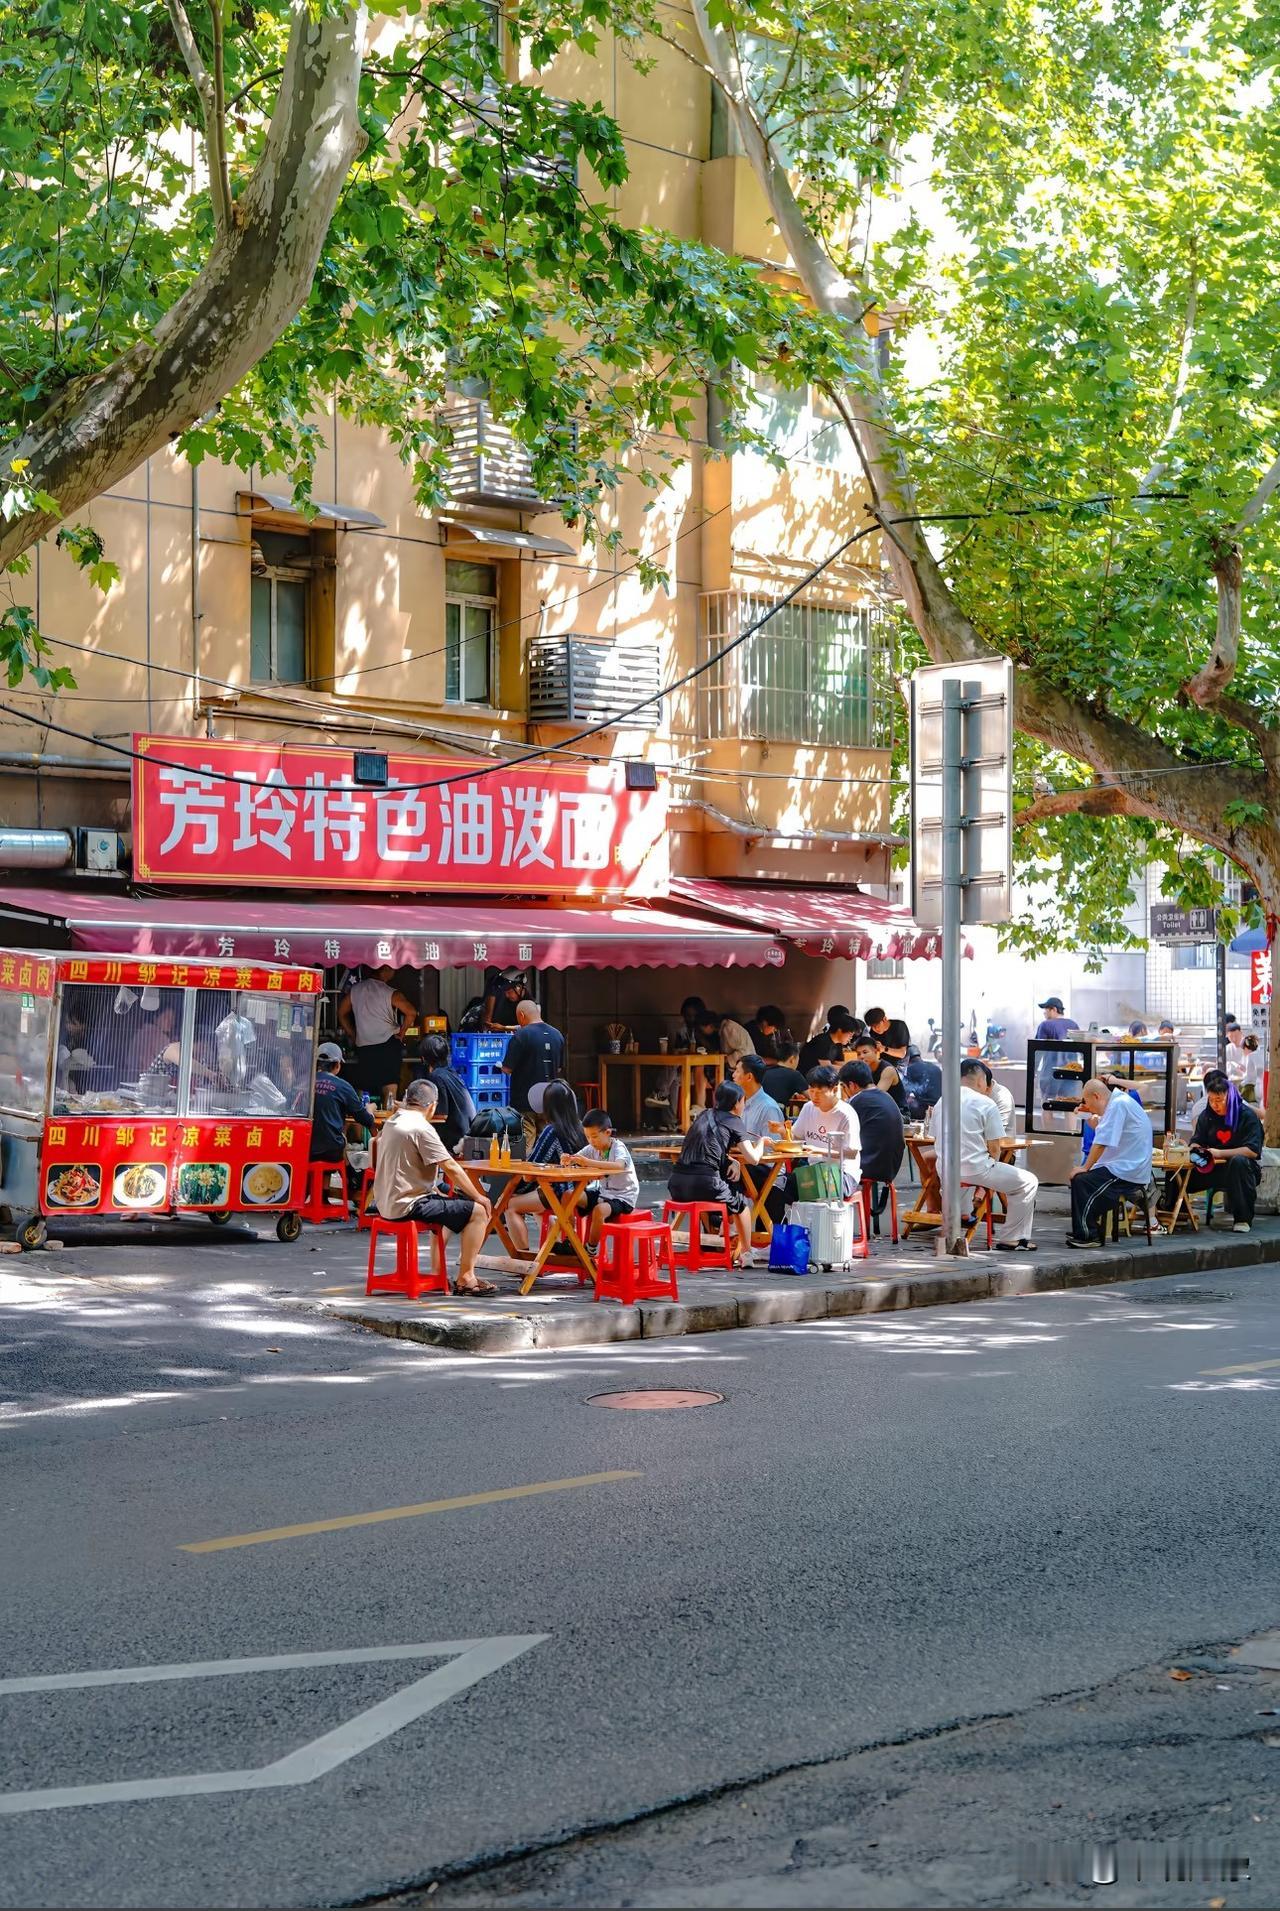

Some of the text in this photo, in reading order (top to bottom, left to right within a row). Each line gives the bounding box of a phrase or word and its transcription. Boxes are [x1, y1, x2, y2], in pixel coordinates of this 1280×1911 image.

[159, 764, 613, 870] 芳玲特色油泼面
[1163, 921, 1181, 929] Toilet
[217, 937, 534, 962] 芳玲特色油泼面
[0, 957, 50, 991] 菜卤肉
[69, 960, 314, 991] 四川邹记凉菜卤肉
[48, 1126, 294, 1148] 四川邹记凉菜卤肉
